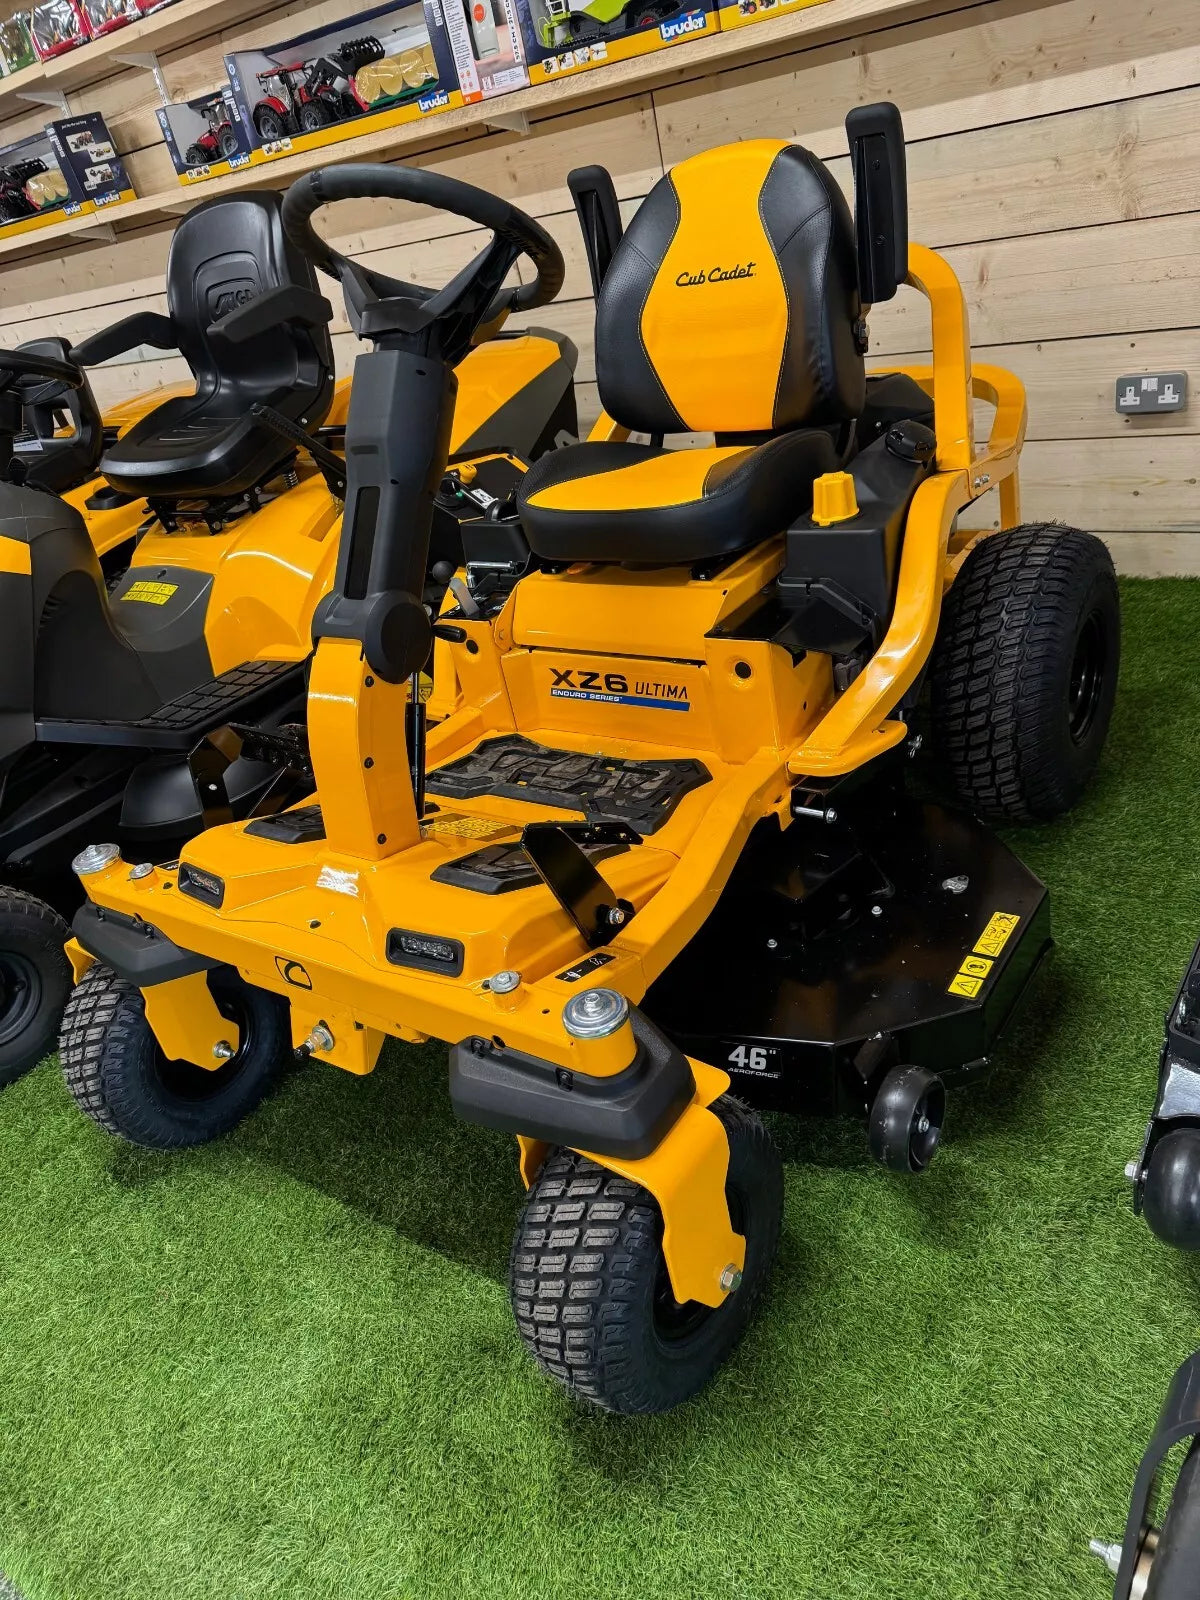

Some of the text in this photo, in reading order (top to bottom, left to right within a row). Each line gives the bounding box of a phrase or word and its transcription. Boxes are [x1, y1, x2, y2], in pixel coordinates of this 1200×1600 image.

[660, 15, 706, 39] bruder
[419, 94, 448, 110] bruder
[675, 261, 757, 287] Cub Cadet
[549, 668, 688, 700] XZ6 ULTIMA
[552, 689, 621, 703] ENDURO SERIES
[728, 1045, 777, 1071] 46"
[727, 1067, 779, 1079] AEROFORCE
